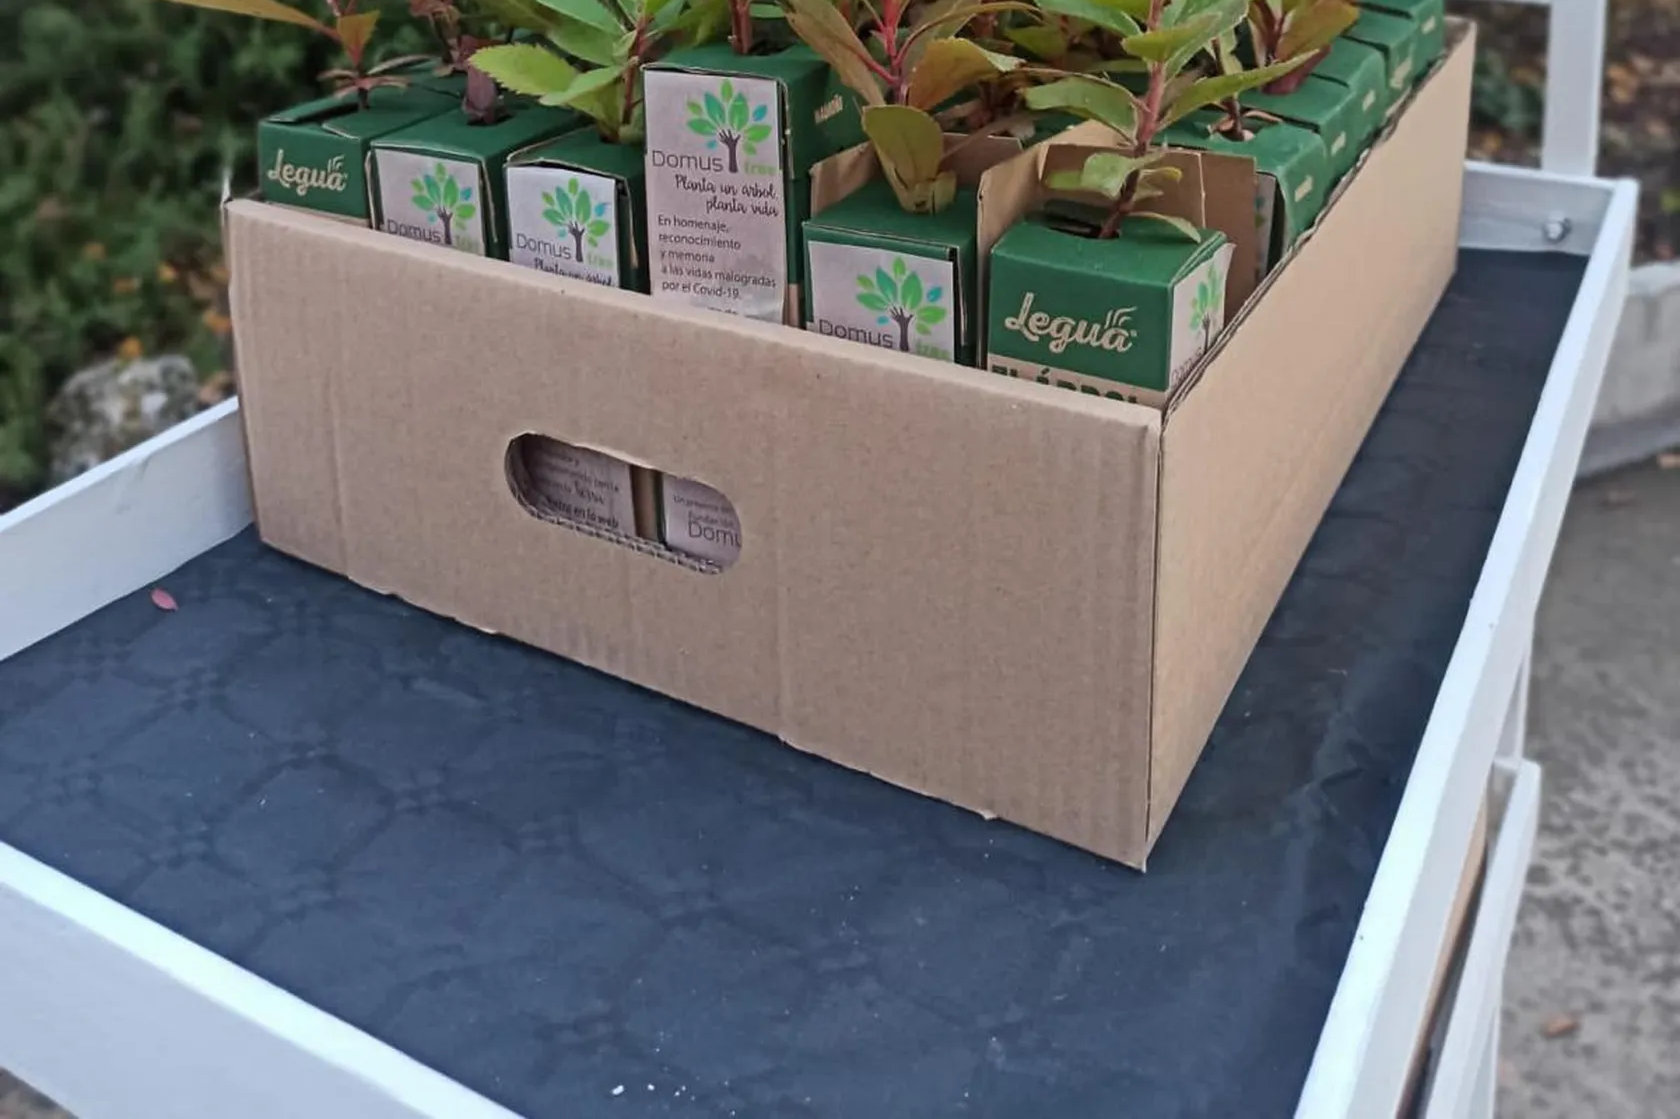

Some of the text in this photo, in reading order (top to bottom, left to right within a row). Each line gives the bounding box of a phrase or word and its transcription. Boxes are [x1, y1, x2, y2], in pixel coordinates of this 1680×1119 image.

[652, 150, 724, 172] Domus
[675, 174, 715, 194] Planta
[720, 183, 738, 196] un
[706, 196, 778, 217] planta vida
[387, 219, 441, 243] Domus
[658, 215, 671, 226] En
[516, 232, 572, 260] Domus
[659, 233, 741, 250] reconocimiento
[668, 250, 715, 262] memoria
[662, 281, 680, 293] por
[682, 282, 691, 293] el
[669, 264, 683, 276] las
[686, 267, 713, 280] vidas
[714, 270, 777, 288] malogradas
[819, 319, 894, 349] Domus
[688, 521, 742, 549] Domu
